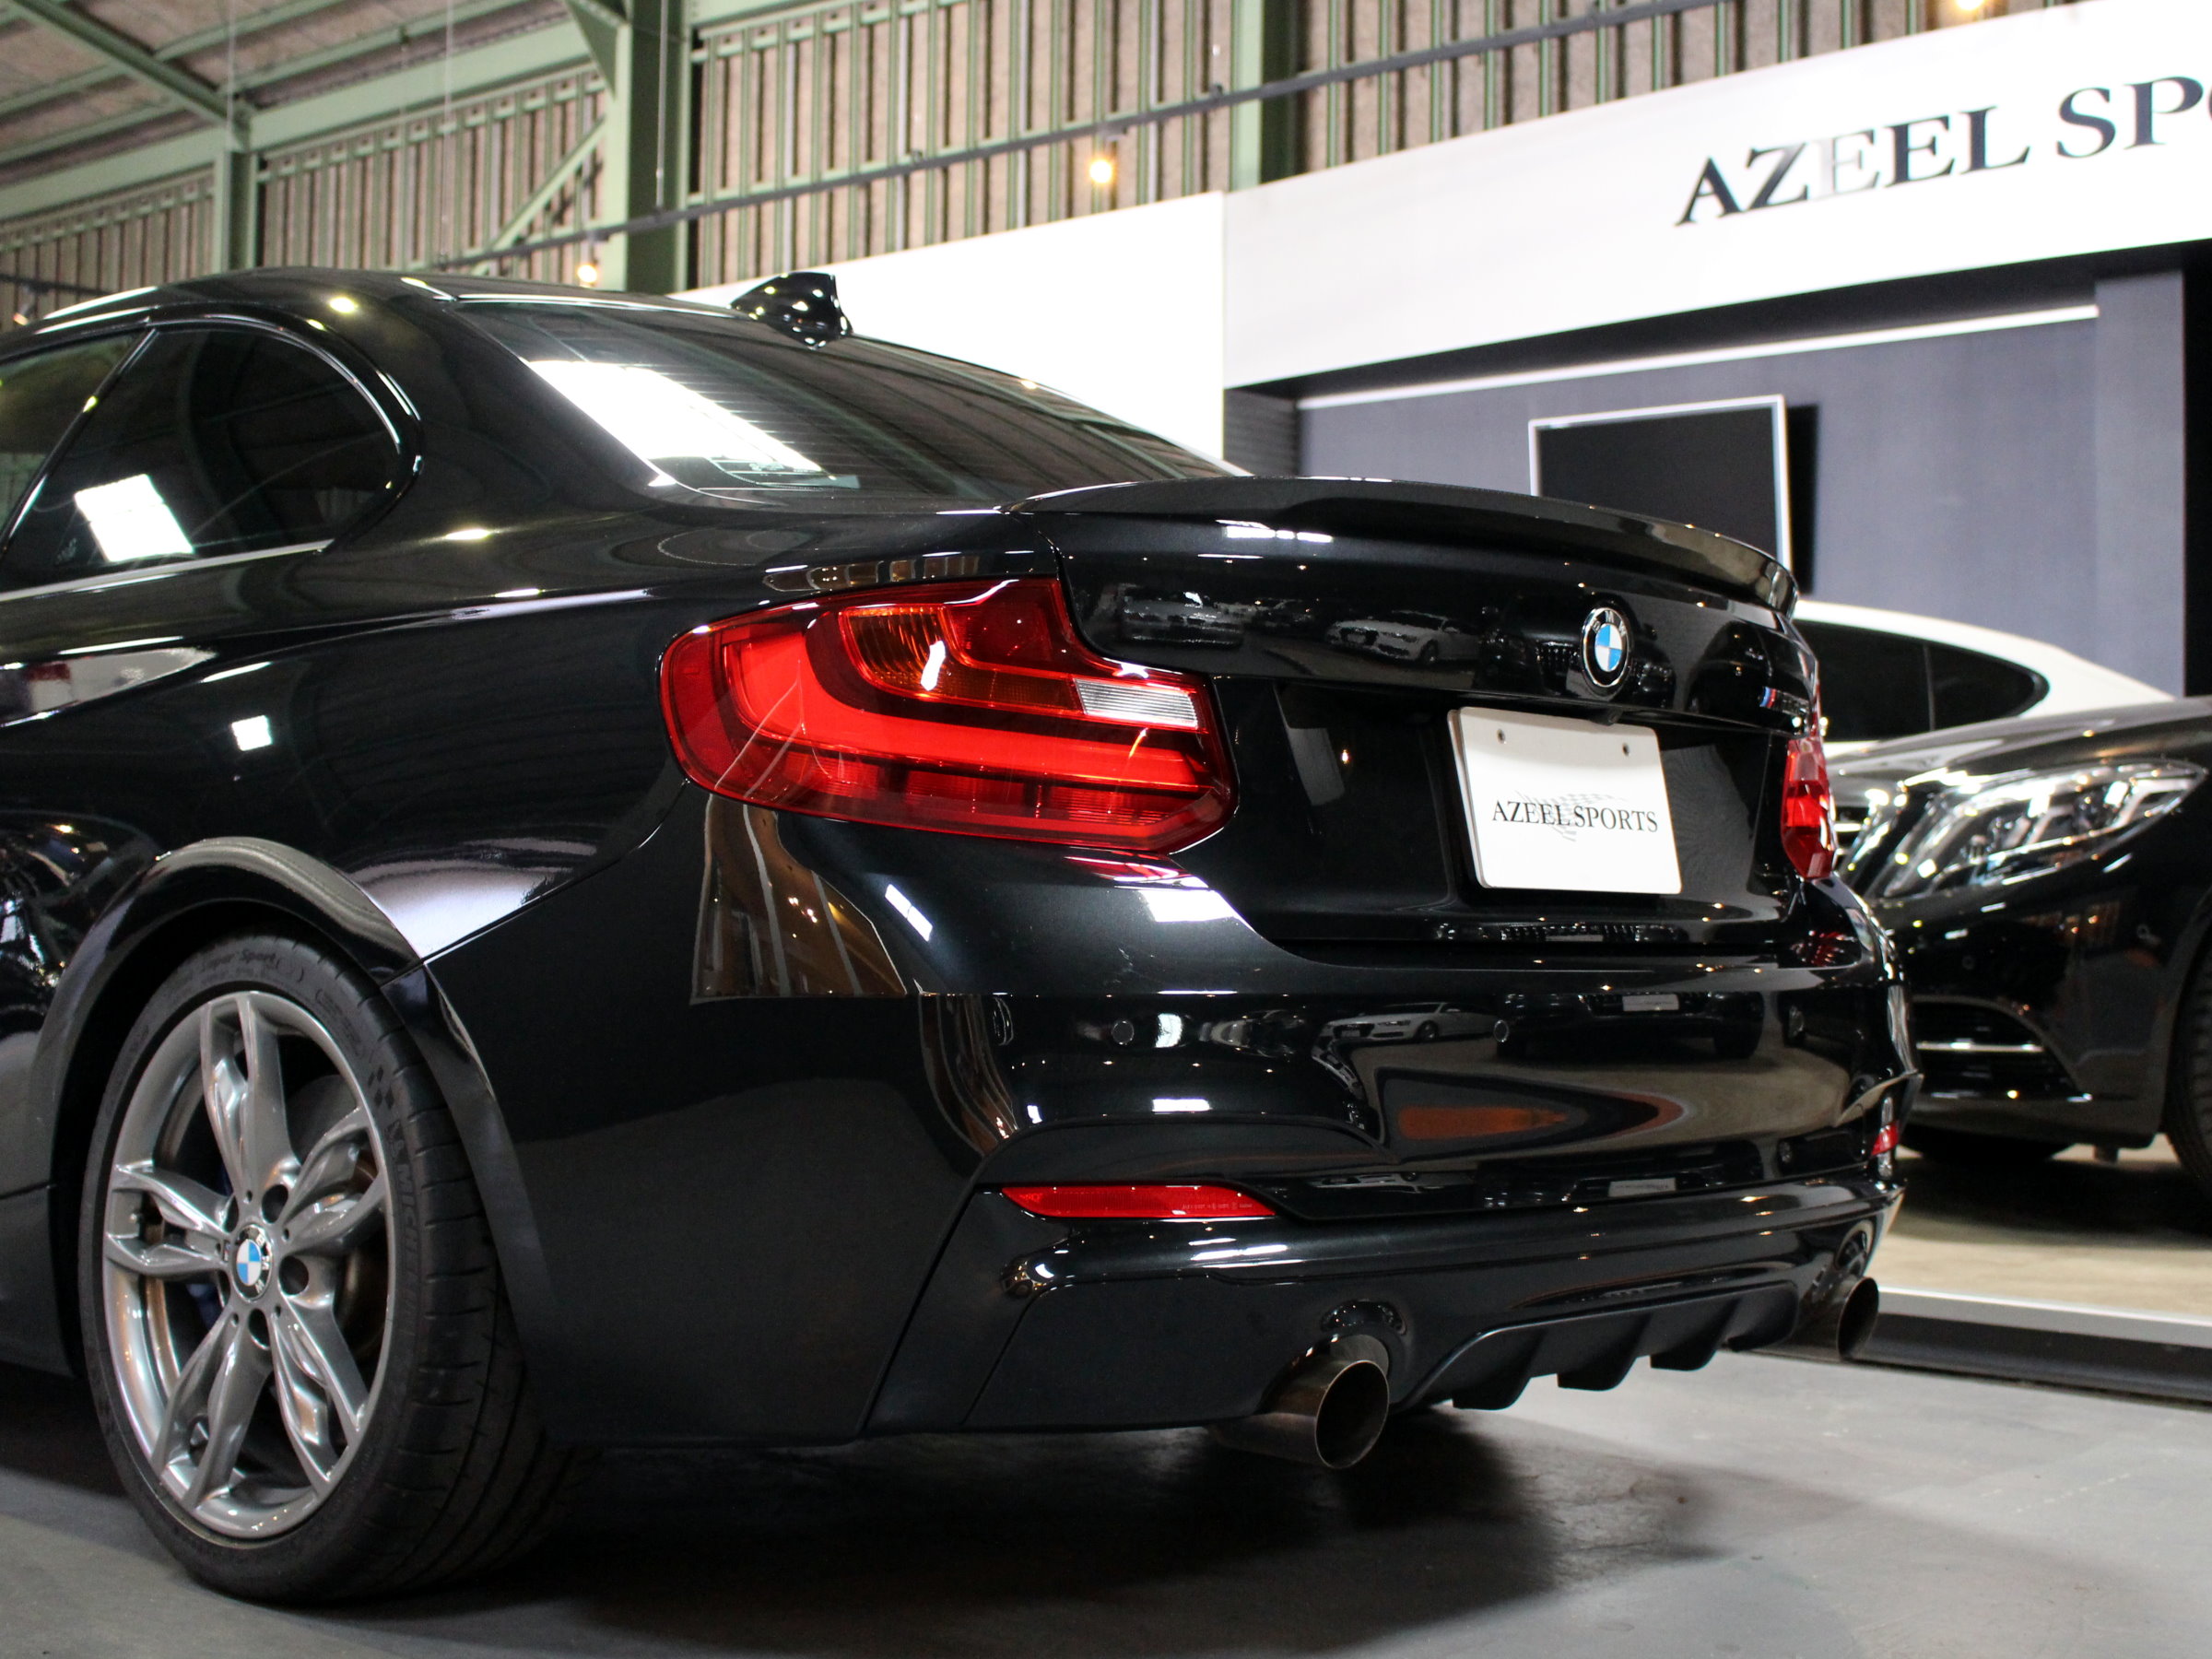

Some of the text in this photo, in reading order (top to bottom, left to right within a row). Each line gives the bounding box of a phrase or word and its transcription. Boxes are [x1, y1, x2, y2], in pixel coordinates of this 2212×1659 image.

[1673, 74, 2212, 228] AZEEL SP
[1491, 799, 1658, 833] AZEEL SPORTS
